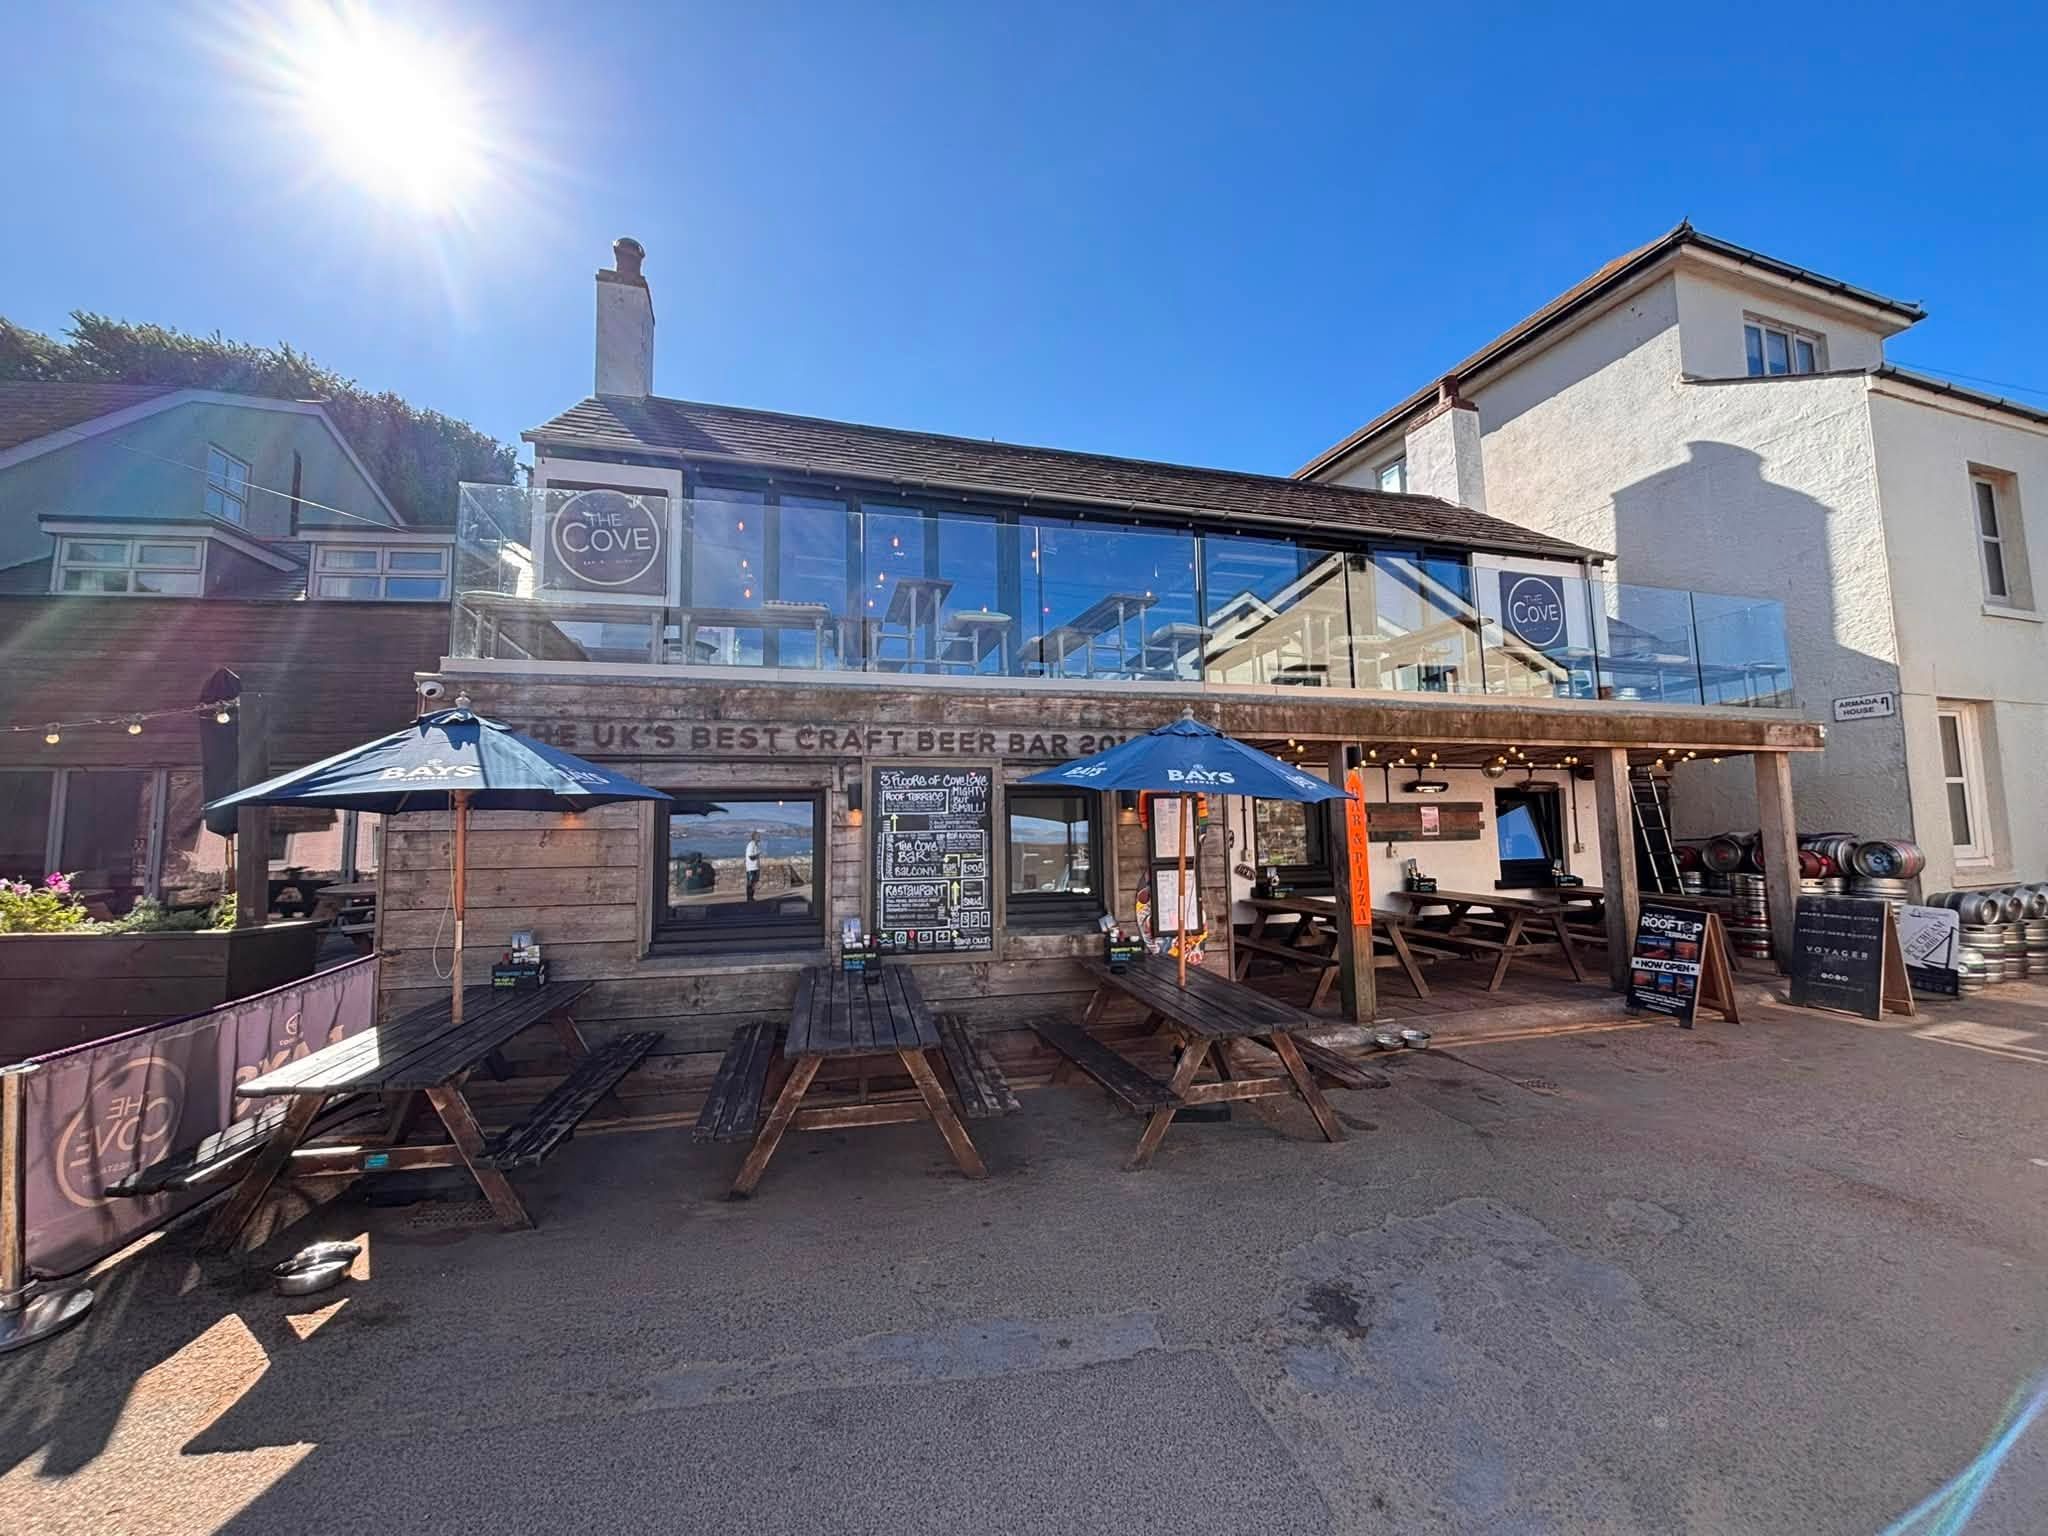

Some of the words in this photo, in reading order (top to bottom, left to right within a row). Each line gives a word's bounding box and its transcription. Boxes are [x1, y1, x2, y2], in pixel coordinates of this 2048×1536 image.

[586, 512, 623, 527] THE
[562, 522, 652, 552] COVE
[1523, 593, 1543, 605] THE
[1513, 601, 1560, 624] COVE
[1839, 698, 1879, 708] ARMADA
[1843, 706, 1875, 716] HOUSE
[593, 724, 676, 748] UK'S
[691, 726, 782, 750] BEST
[795, 726, 904, 751] CRAFT
[917, 730, 996, 753] BEER
[1008, 733, 1069, 755] BAR
[379, 766, 482, 780] BAYS
[1062, 766, 1107, 778] BAYS
[1168, 769, 1235, 784] BAYS
[1355, 851, 1367, 922] PIZZA
[1806, 945, 1869, 960] VOYAGER
[1640, 960, 1663, 969] NOW
[1664, 962, 1690, 972] OPEN
